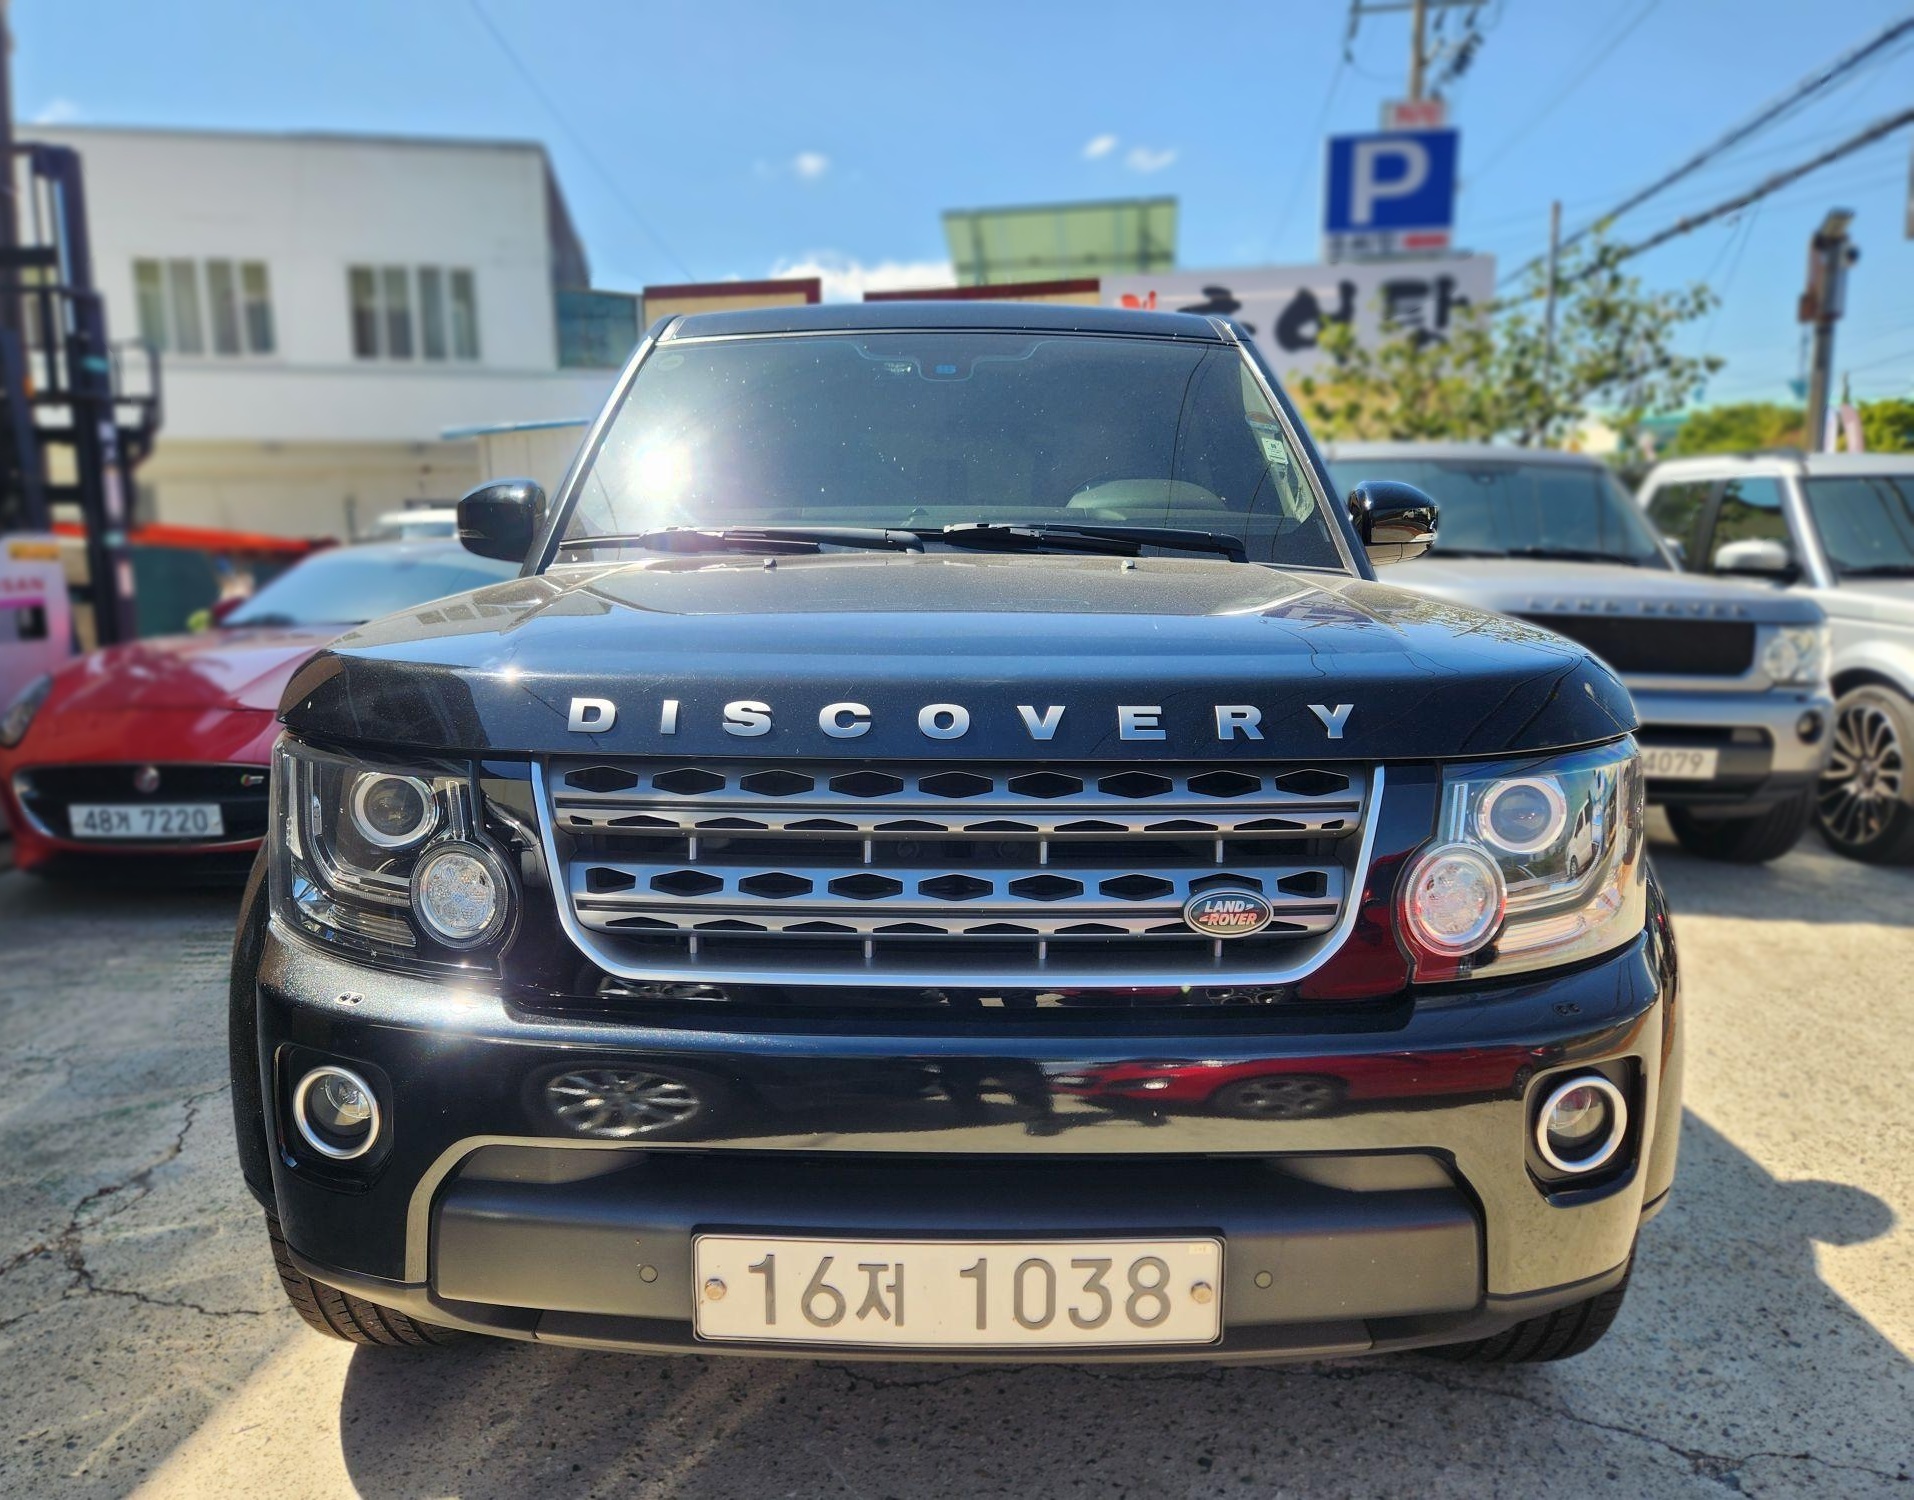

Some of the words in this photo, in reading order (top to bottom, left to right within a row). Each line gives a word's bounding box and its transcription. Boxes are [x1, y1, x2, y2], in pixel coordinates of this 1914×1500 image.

[1351, 138, 1430, 224] P
[567, 697, 1355, 741] DISCOVERY
[141, 808, 208, 833] 7220
[1204, 900, 1246, 913] LAND
[1207, 912, 1258, 926] ROVER
[748, 1253, 905, 1328] 16저
[959, 1256, 1172, 1330] 1038
